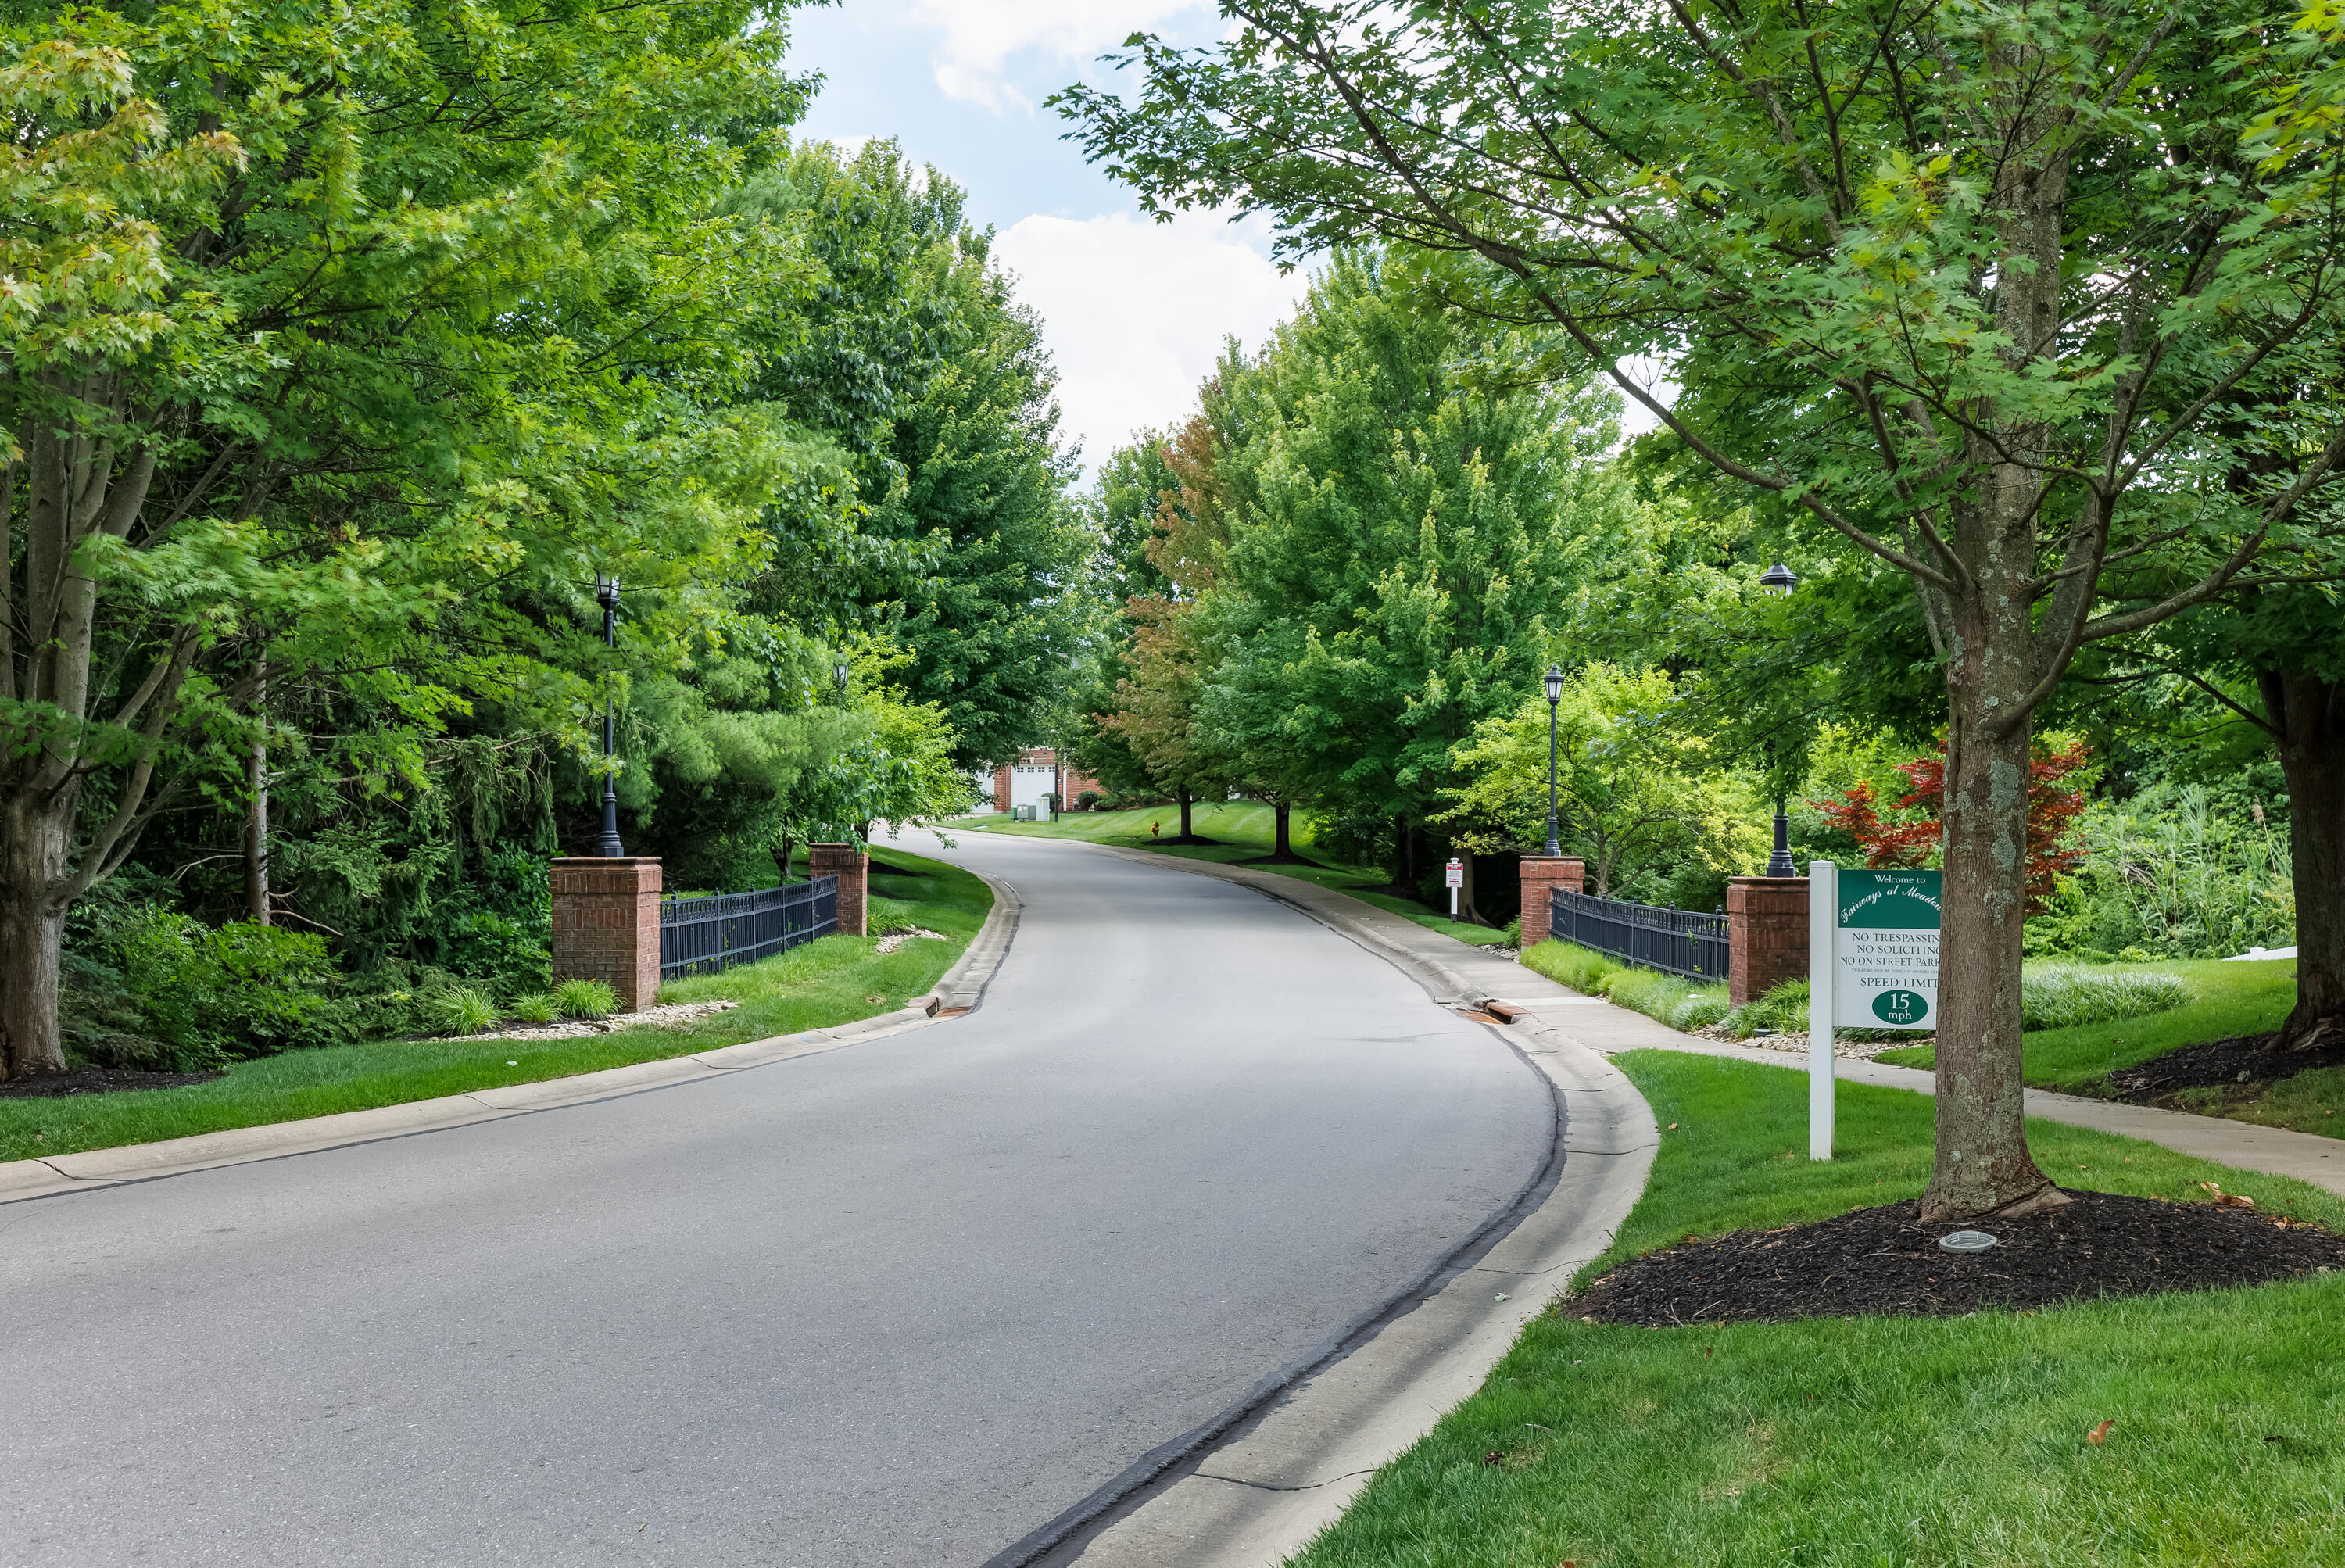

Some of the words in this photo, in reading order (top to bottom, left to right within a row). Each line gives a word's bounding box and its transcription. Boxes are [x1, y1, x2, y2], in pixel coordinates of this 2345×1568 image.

[1874, 874, 1914, 884] Welcome
[1840, 890, 1882, 923] Fairways
[1902, 886, 1941, 911] Meadow
[1853, 933, 1869, 941] NO
[1873, 933, 1940, 943] TRESPASSIN
[1857, 944, 1874, 954] NO
[1841, 956, 1855, 965] NO
[1858, 957, 1873, 965] ON
[1876, 957, 1912, 966] STREET
[1916, 958, 1939, 967] PARK
[1860, 977, 1899, 987] SPEED
[1904, 978, 1939, 988] LIMIT
[1890, 993, 1910, 1010] 15
[1888, 1009, 1912, 1022] mph
